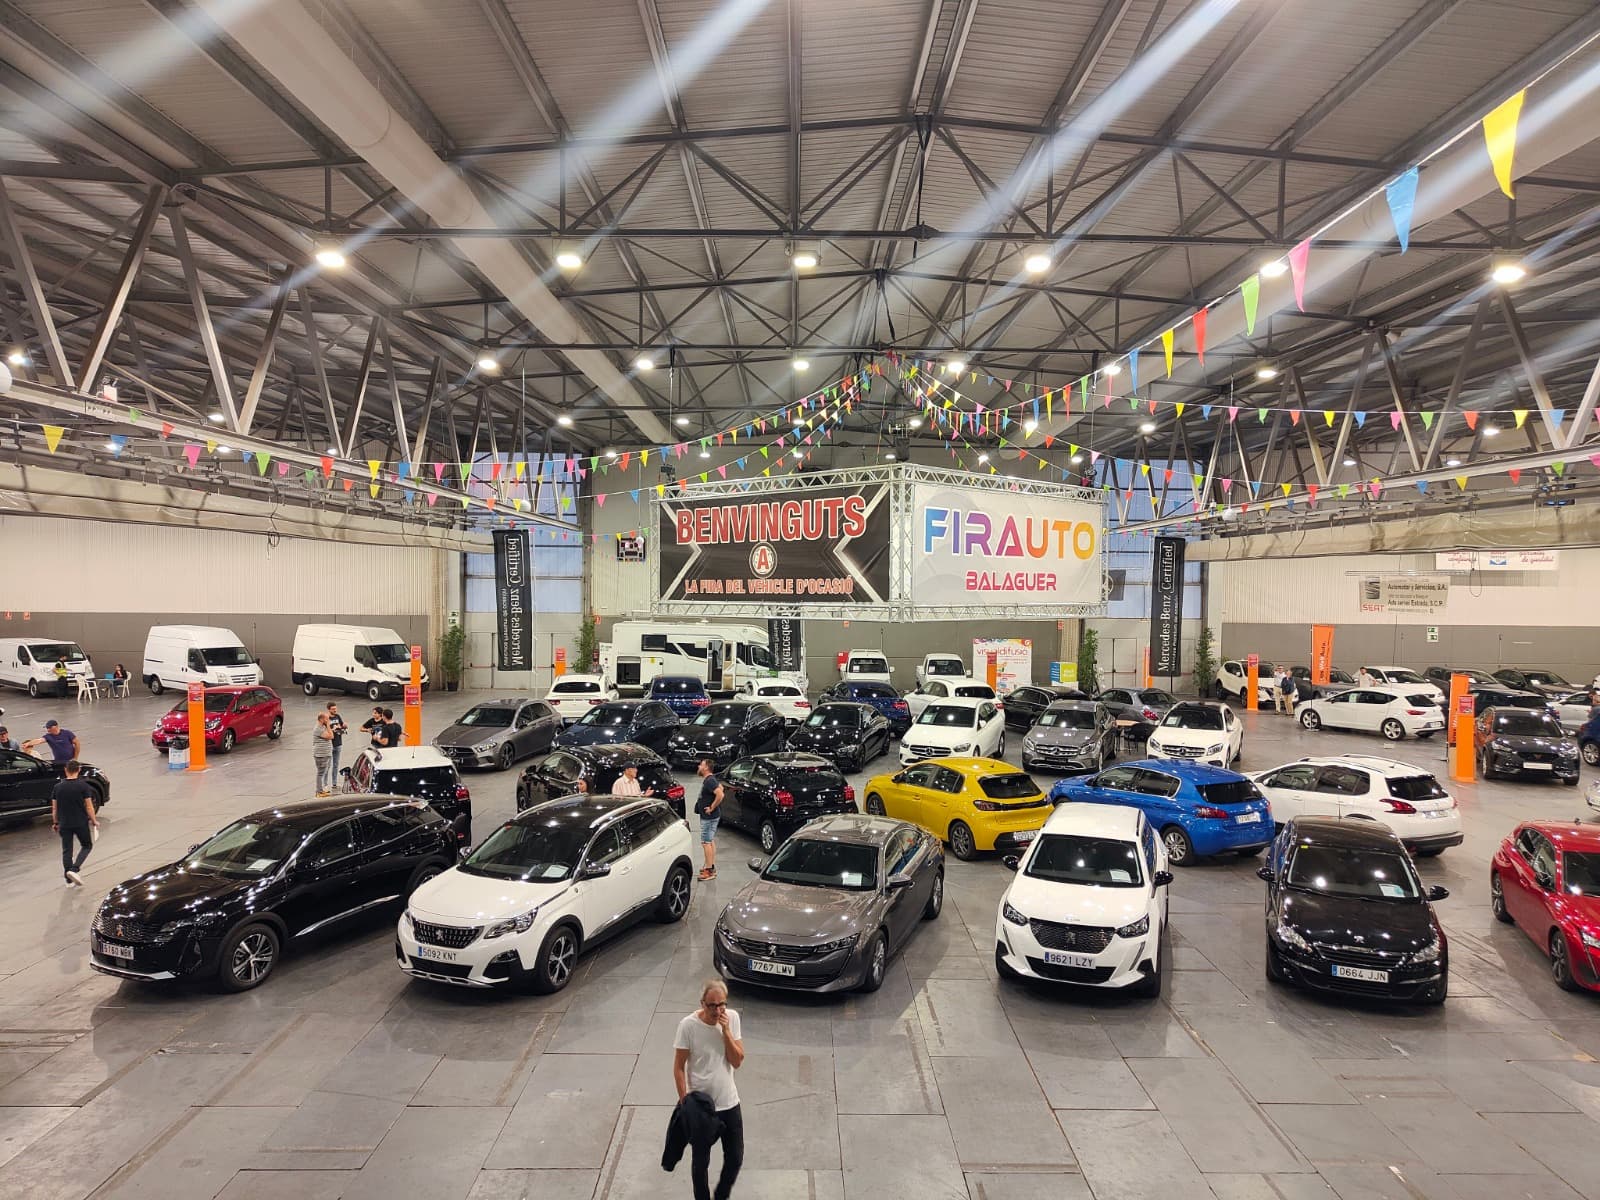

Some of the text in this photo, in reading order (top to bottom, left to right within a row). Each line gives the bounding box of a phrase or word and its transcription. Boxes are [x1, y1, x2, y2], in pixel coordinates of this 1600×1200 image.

[676, 496, 866, 544] BENVINGUTS
[925, 508, 1095, 560] FIRAUTO
[685, 575, 854, 594] LA FIRA DEL VEHICLE D'OCASIÓ
[966, 571, 1057, 591] BALAGUER
[1158, 545, 1173, 672] Mercedes-Benz Certified
[1362, 604, 1384, 612] SEAT
[423, 948, 440, 959] 5092
[1050, 954, 1093, 967] 9621 LZY
[1368, 971, 1387, 981] JJN
